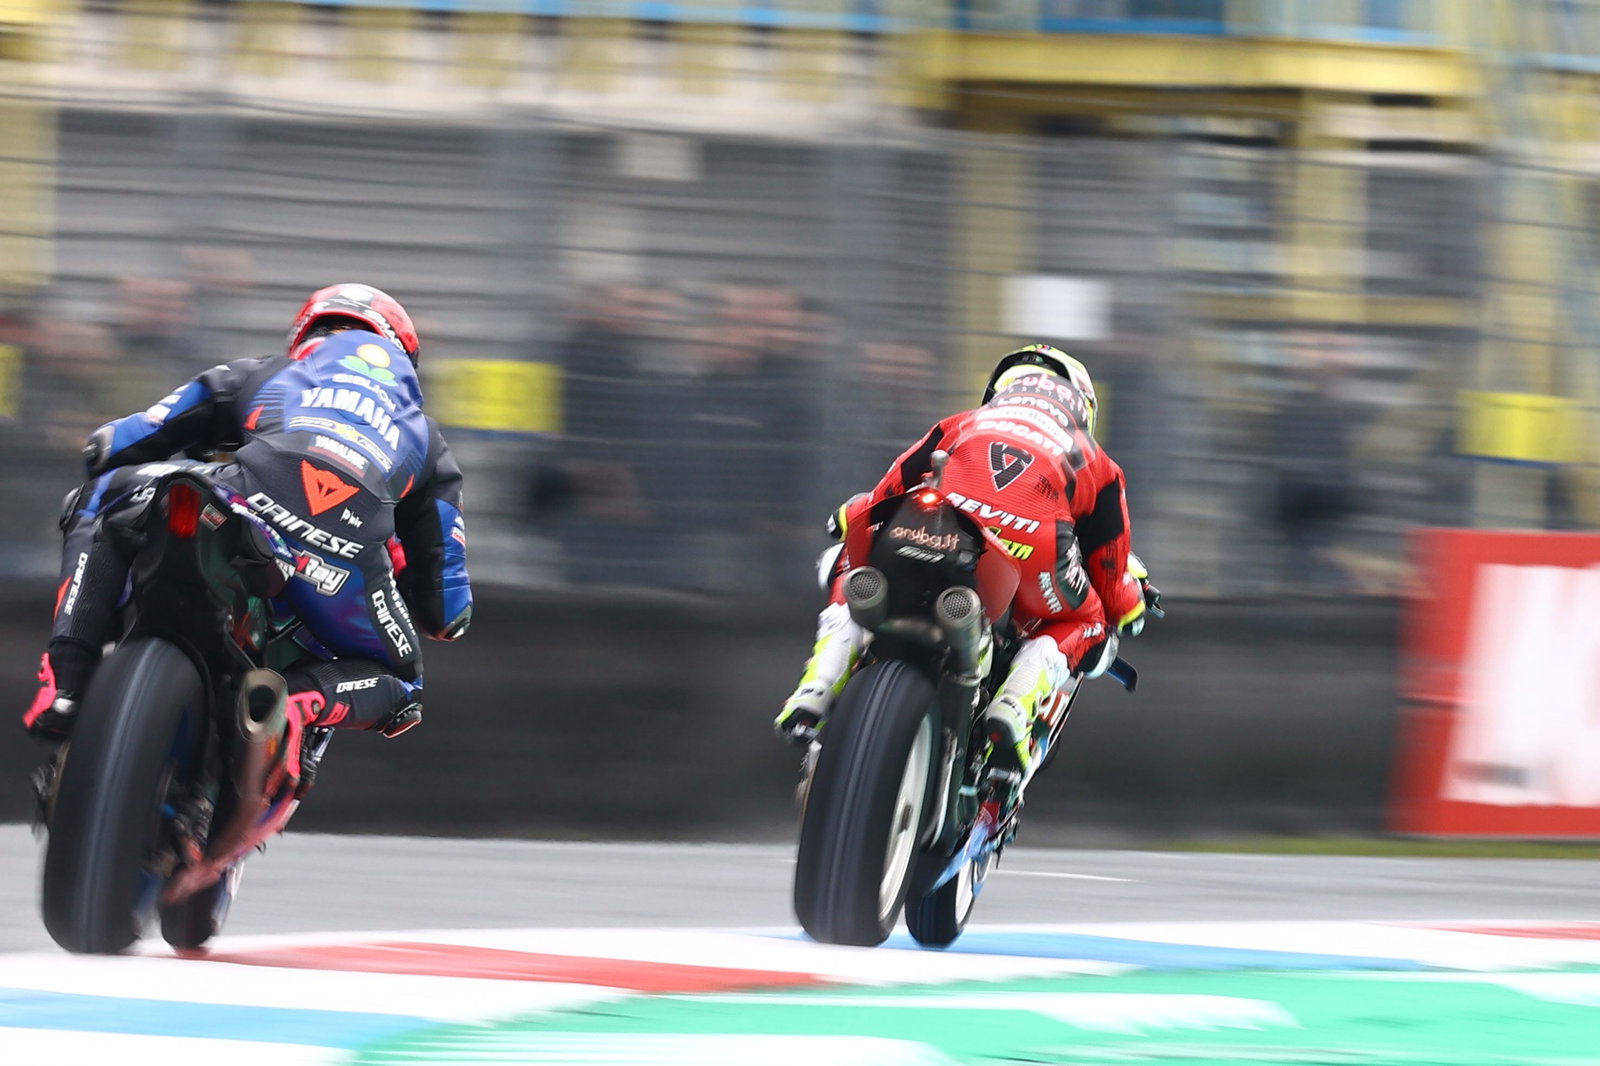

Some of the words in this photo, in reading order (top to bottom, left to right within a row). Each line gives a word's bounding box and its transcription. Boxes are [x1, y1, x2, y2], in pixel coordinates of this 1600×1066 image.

[300, 386, 400, 451] YAMAHA
[975, 420, 1064, 457] DUCATI
[997, 396, 1069, 428] Lenovo
[246, 491, 364, 559] DAINESE
[889, 525, 960, 552] aruba.it
[64, 552, 89, 616] DAINESE
[371, 589, 413, 658] DAINESE
